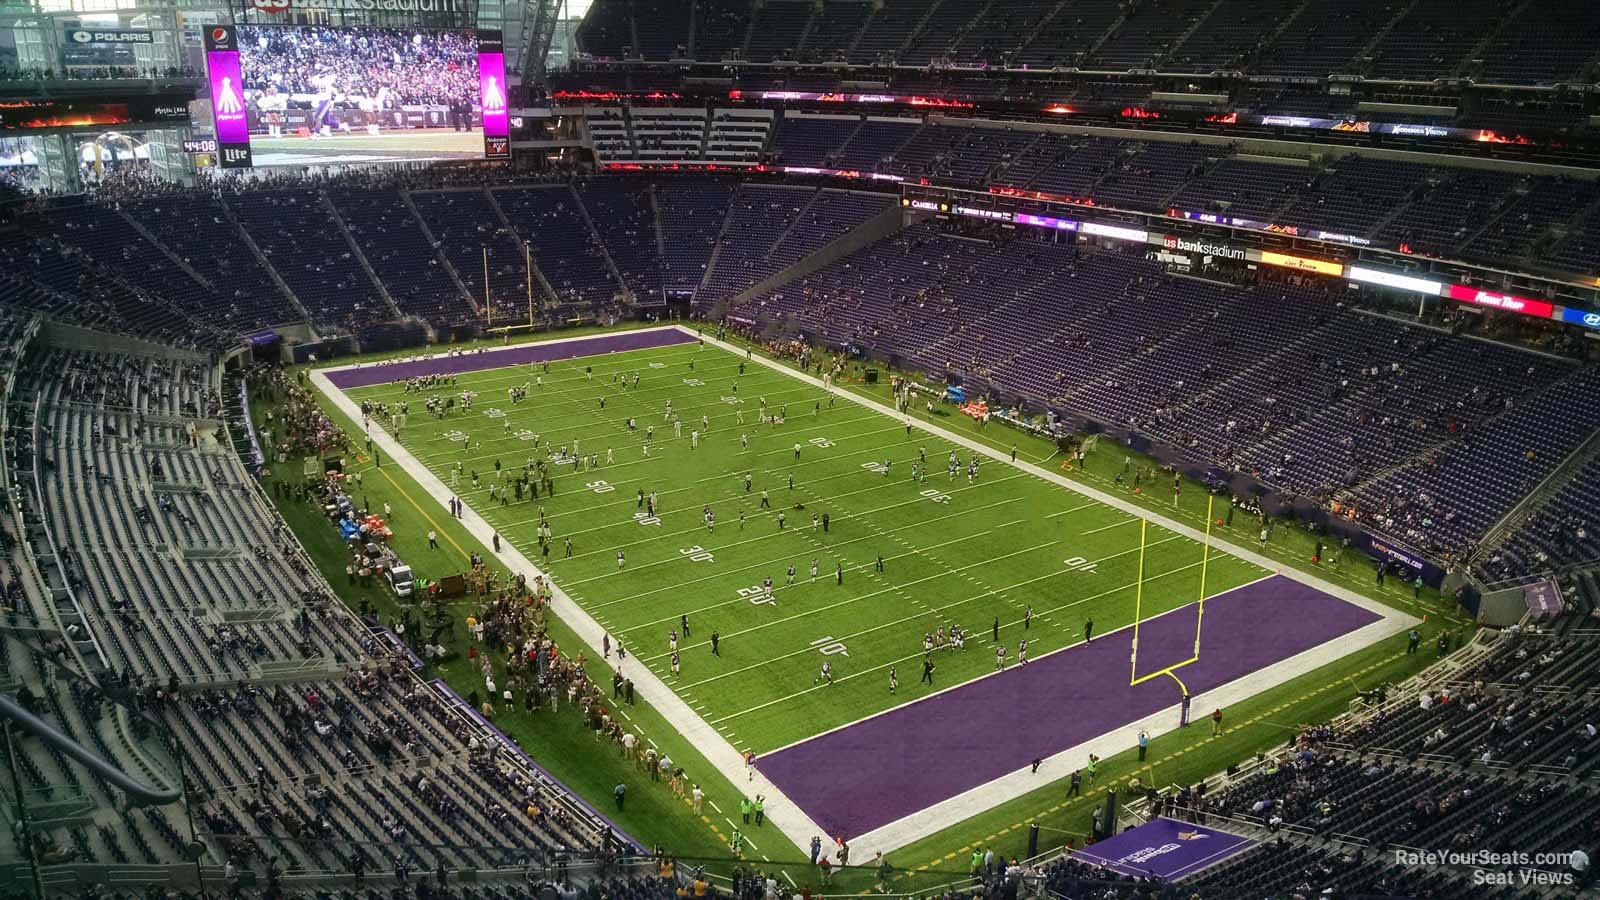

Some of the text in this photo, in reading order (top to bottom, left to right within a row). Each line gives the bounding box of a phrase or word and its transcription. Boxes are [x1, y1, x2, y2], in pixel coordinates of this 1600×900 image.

[95, 32, 151, 42] POLARIS
[510, 117, 523, 128] 40
[184, 140, 216, 152] 44:08
[224, 148, 248, 163] Lite
[586, 480, 615, 493] 50
[679, 545, 714, 562] 30
[736, 585, 776, 606] 20
[809, 635, 849, 656] 10
